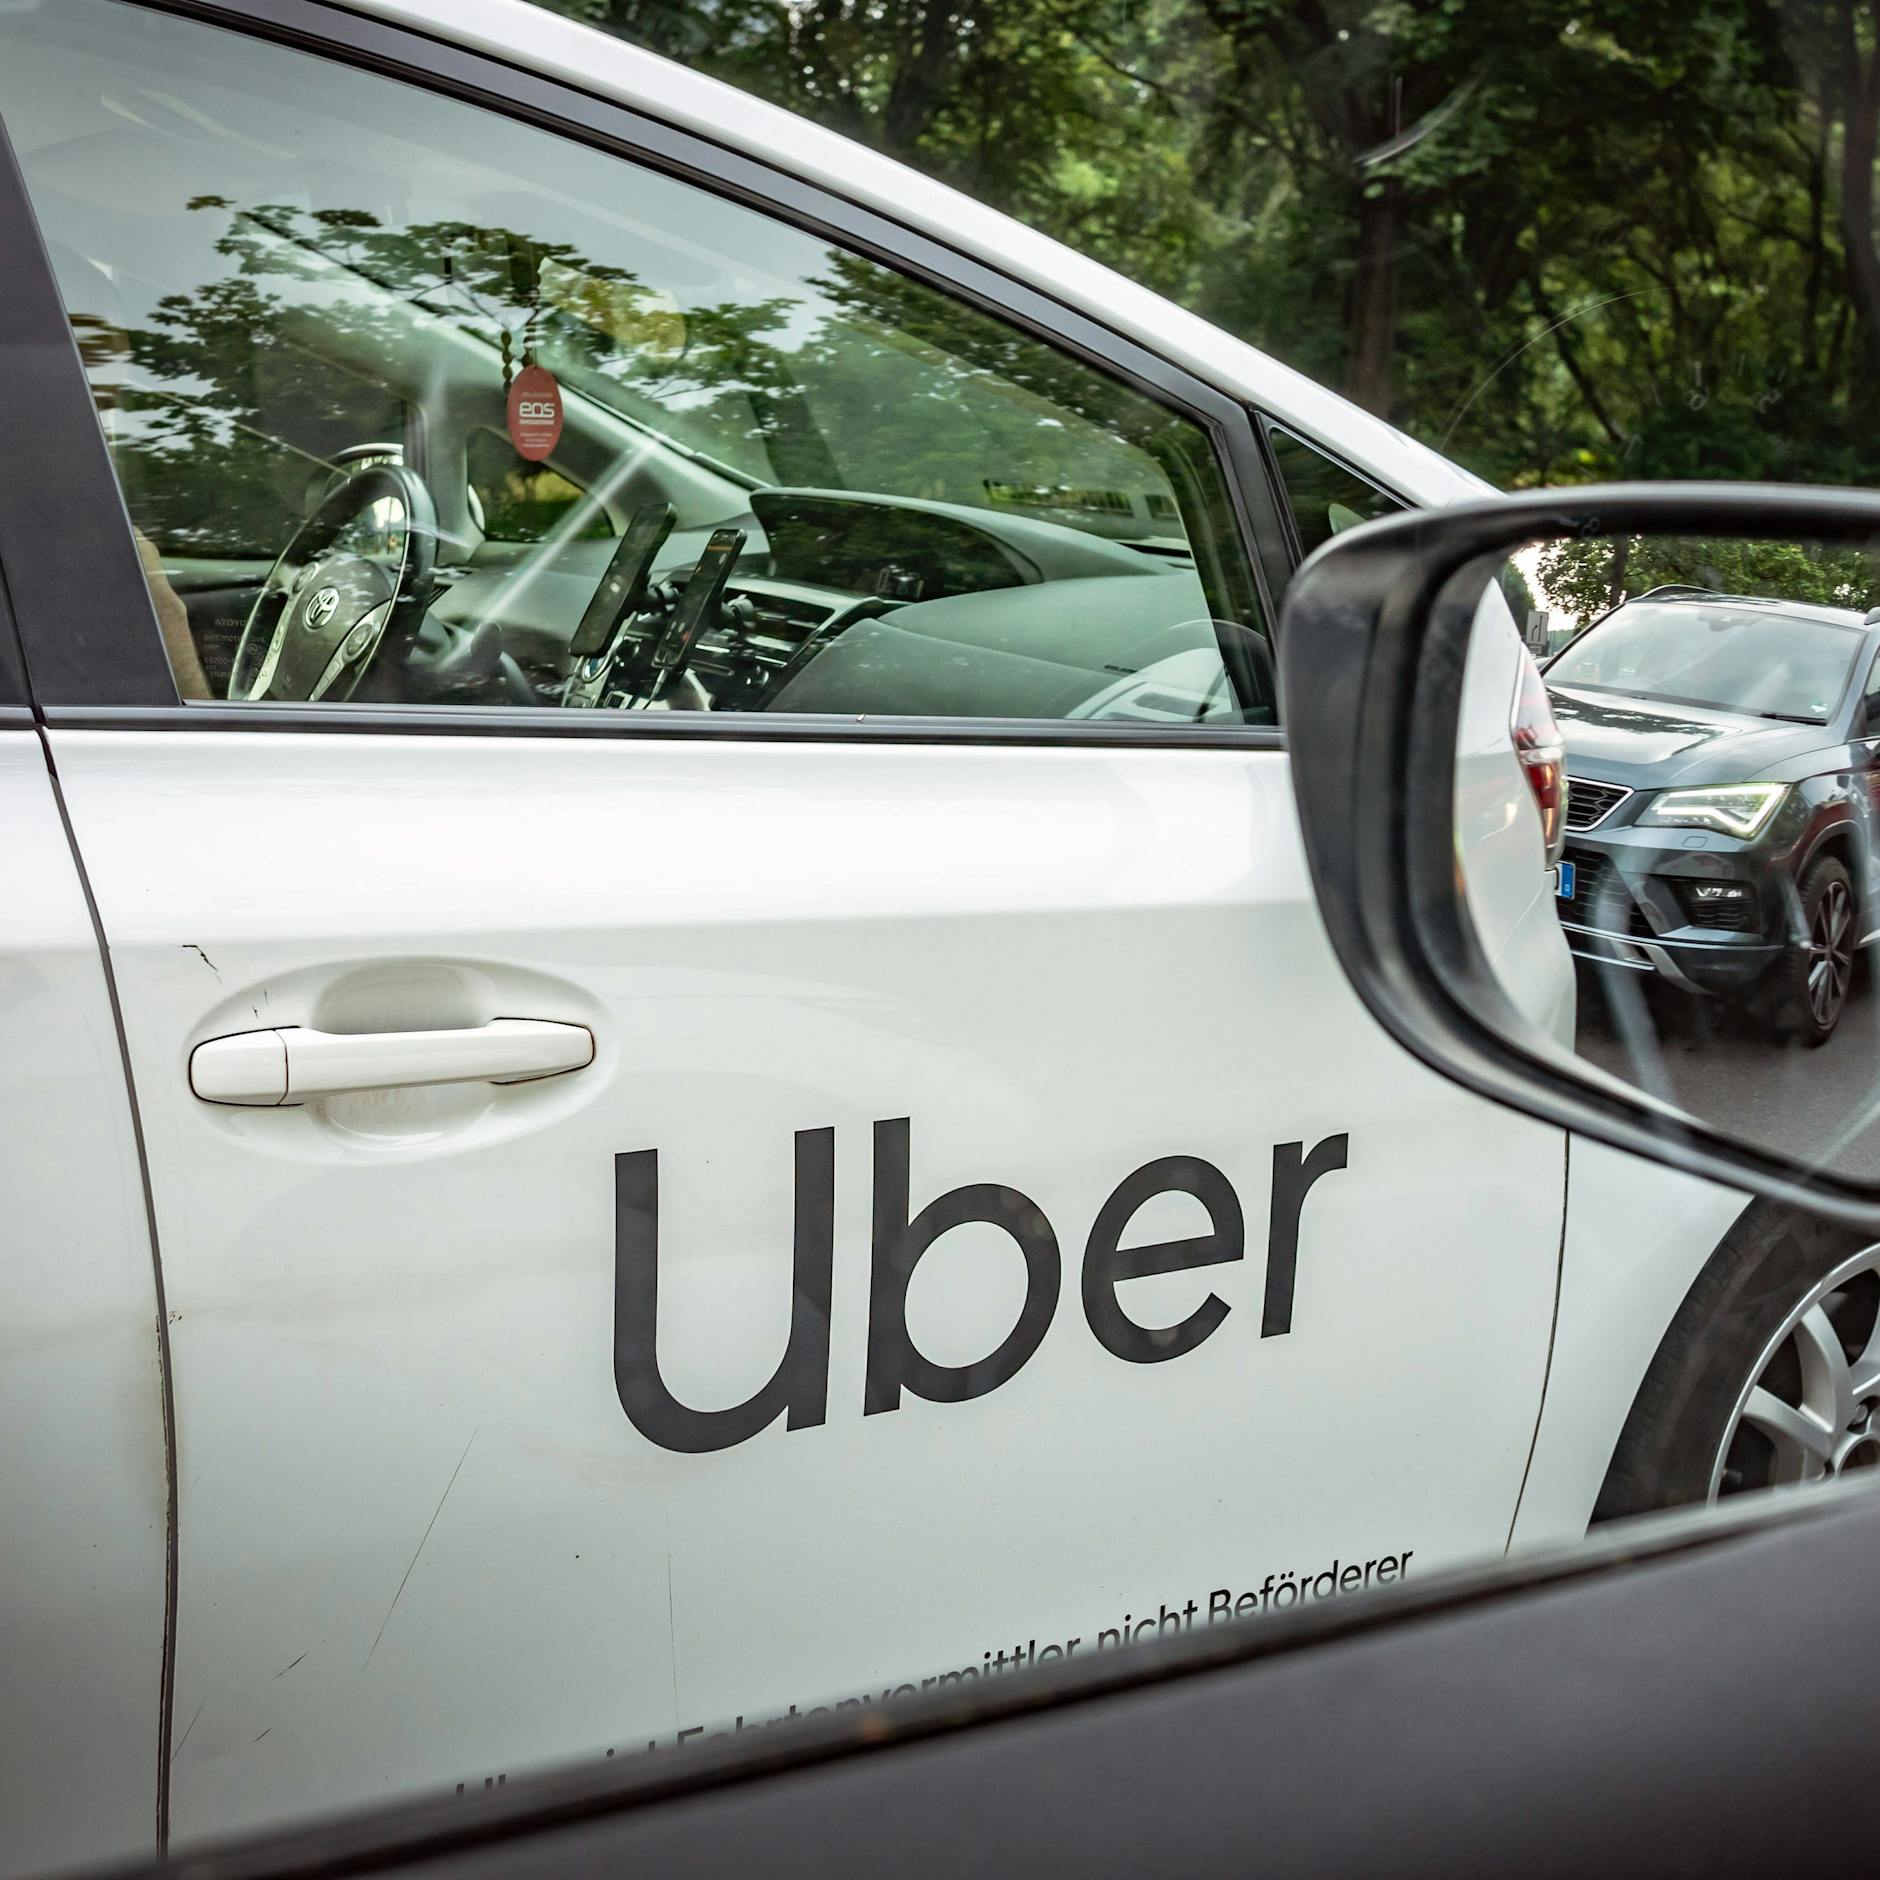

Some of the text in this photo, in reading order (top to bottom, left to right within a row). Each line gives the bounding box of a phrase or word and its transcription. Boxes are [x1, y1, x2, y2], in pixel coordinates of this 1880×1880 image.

[613, 1116, 1349, 1453] Uber
[1098, 1600, 1198, 1652] nicht
[1207, 1551, 1414, 1627] Beförderer
